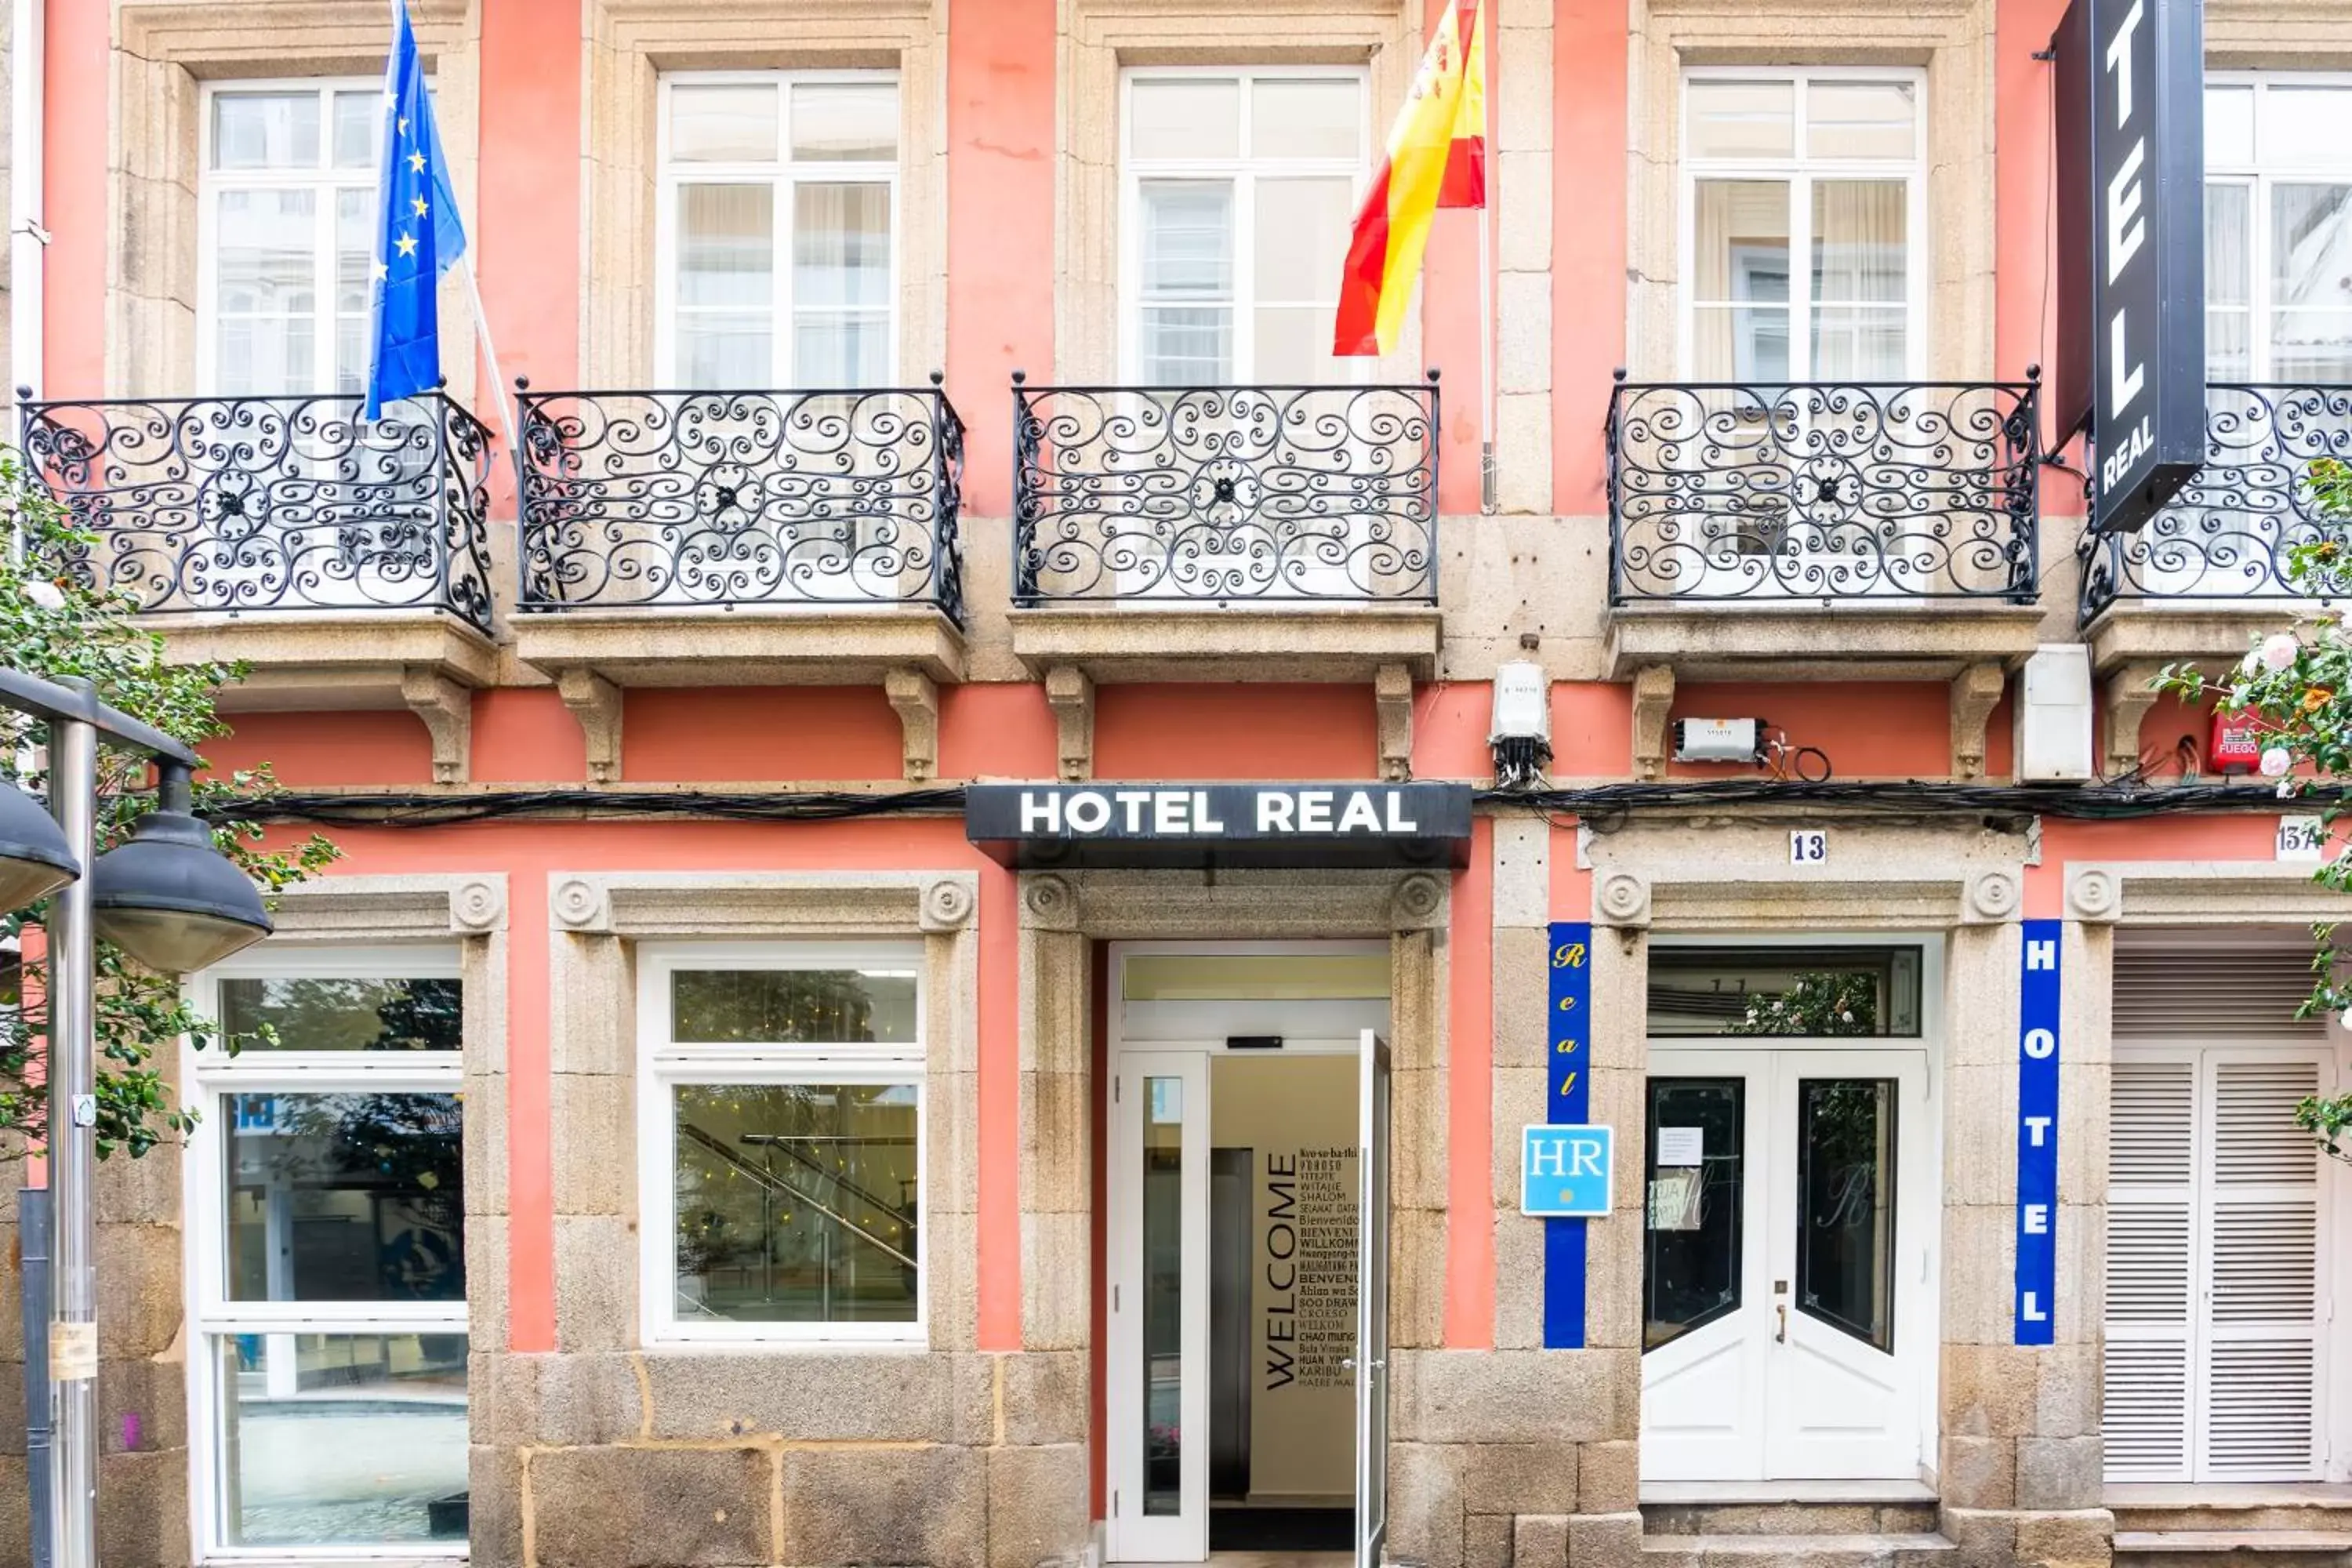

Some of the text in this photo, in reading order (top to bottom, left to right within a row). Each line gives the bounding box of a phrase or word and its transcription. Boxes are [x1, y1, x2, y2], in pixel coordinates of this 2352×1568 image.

[2103, 415, 2154, 496] REAL
[2220, 744, 2257, 753] FUEGO
[1020, 791, 1417, 833] HOTEL REAL
[1795, 835, 1824, 860] 13
[1552, 942, 1588, 1096] Real
[2023, 939, 2056, 1322] HOTEL
[1530, 1138, 1603, 1177] HR
[1300, 1192, 1346, 1202] SHALOM
[1266, 1153, 1296, 1391] WELCOME
[1299, 1298, 1323, 1307] SOO
[1299, 1308, 1348, 1318] CROESO
[1299, 1332, 1326, 1341] CHAO
[1299, 1355, 1324, 1364] HUAN
[1299, 1366, 1341, 1377] KARIBU
